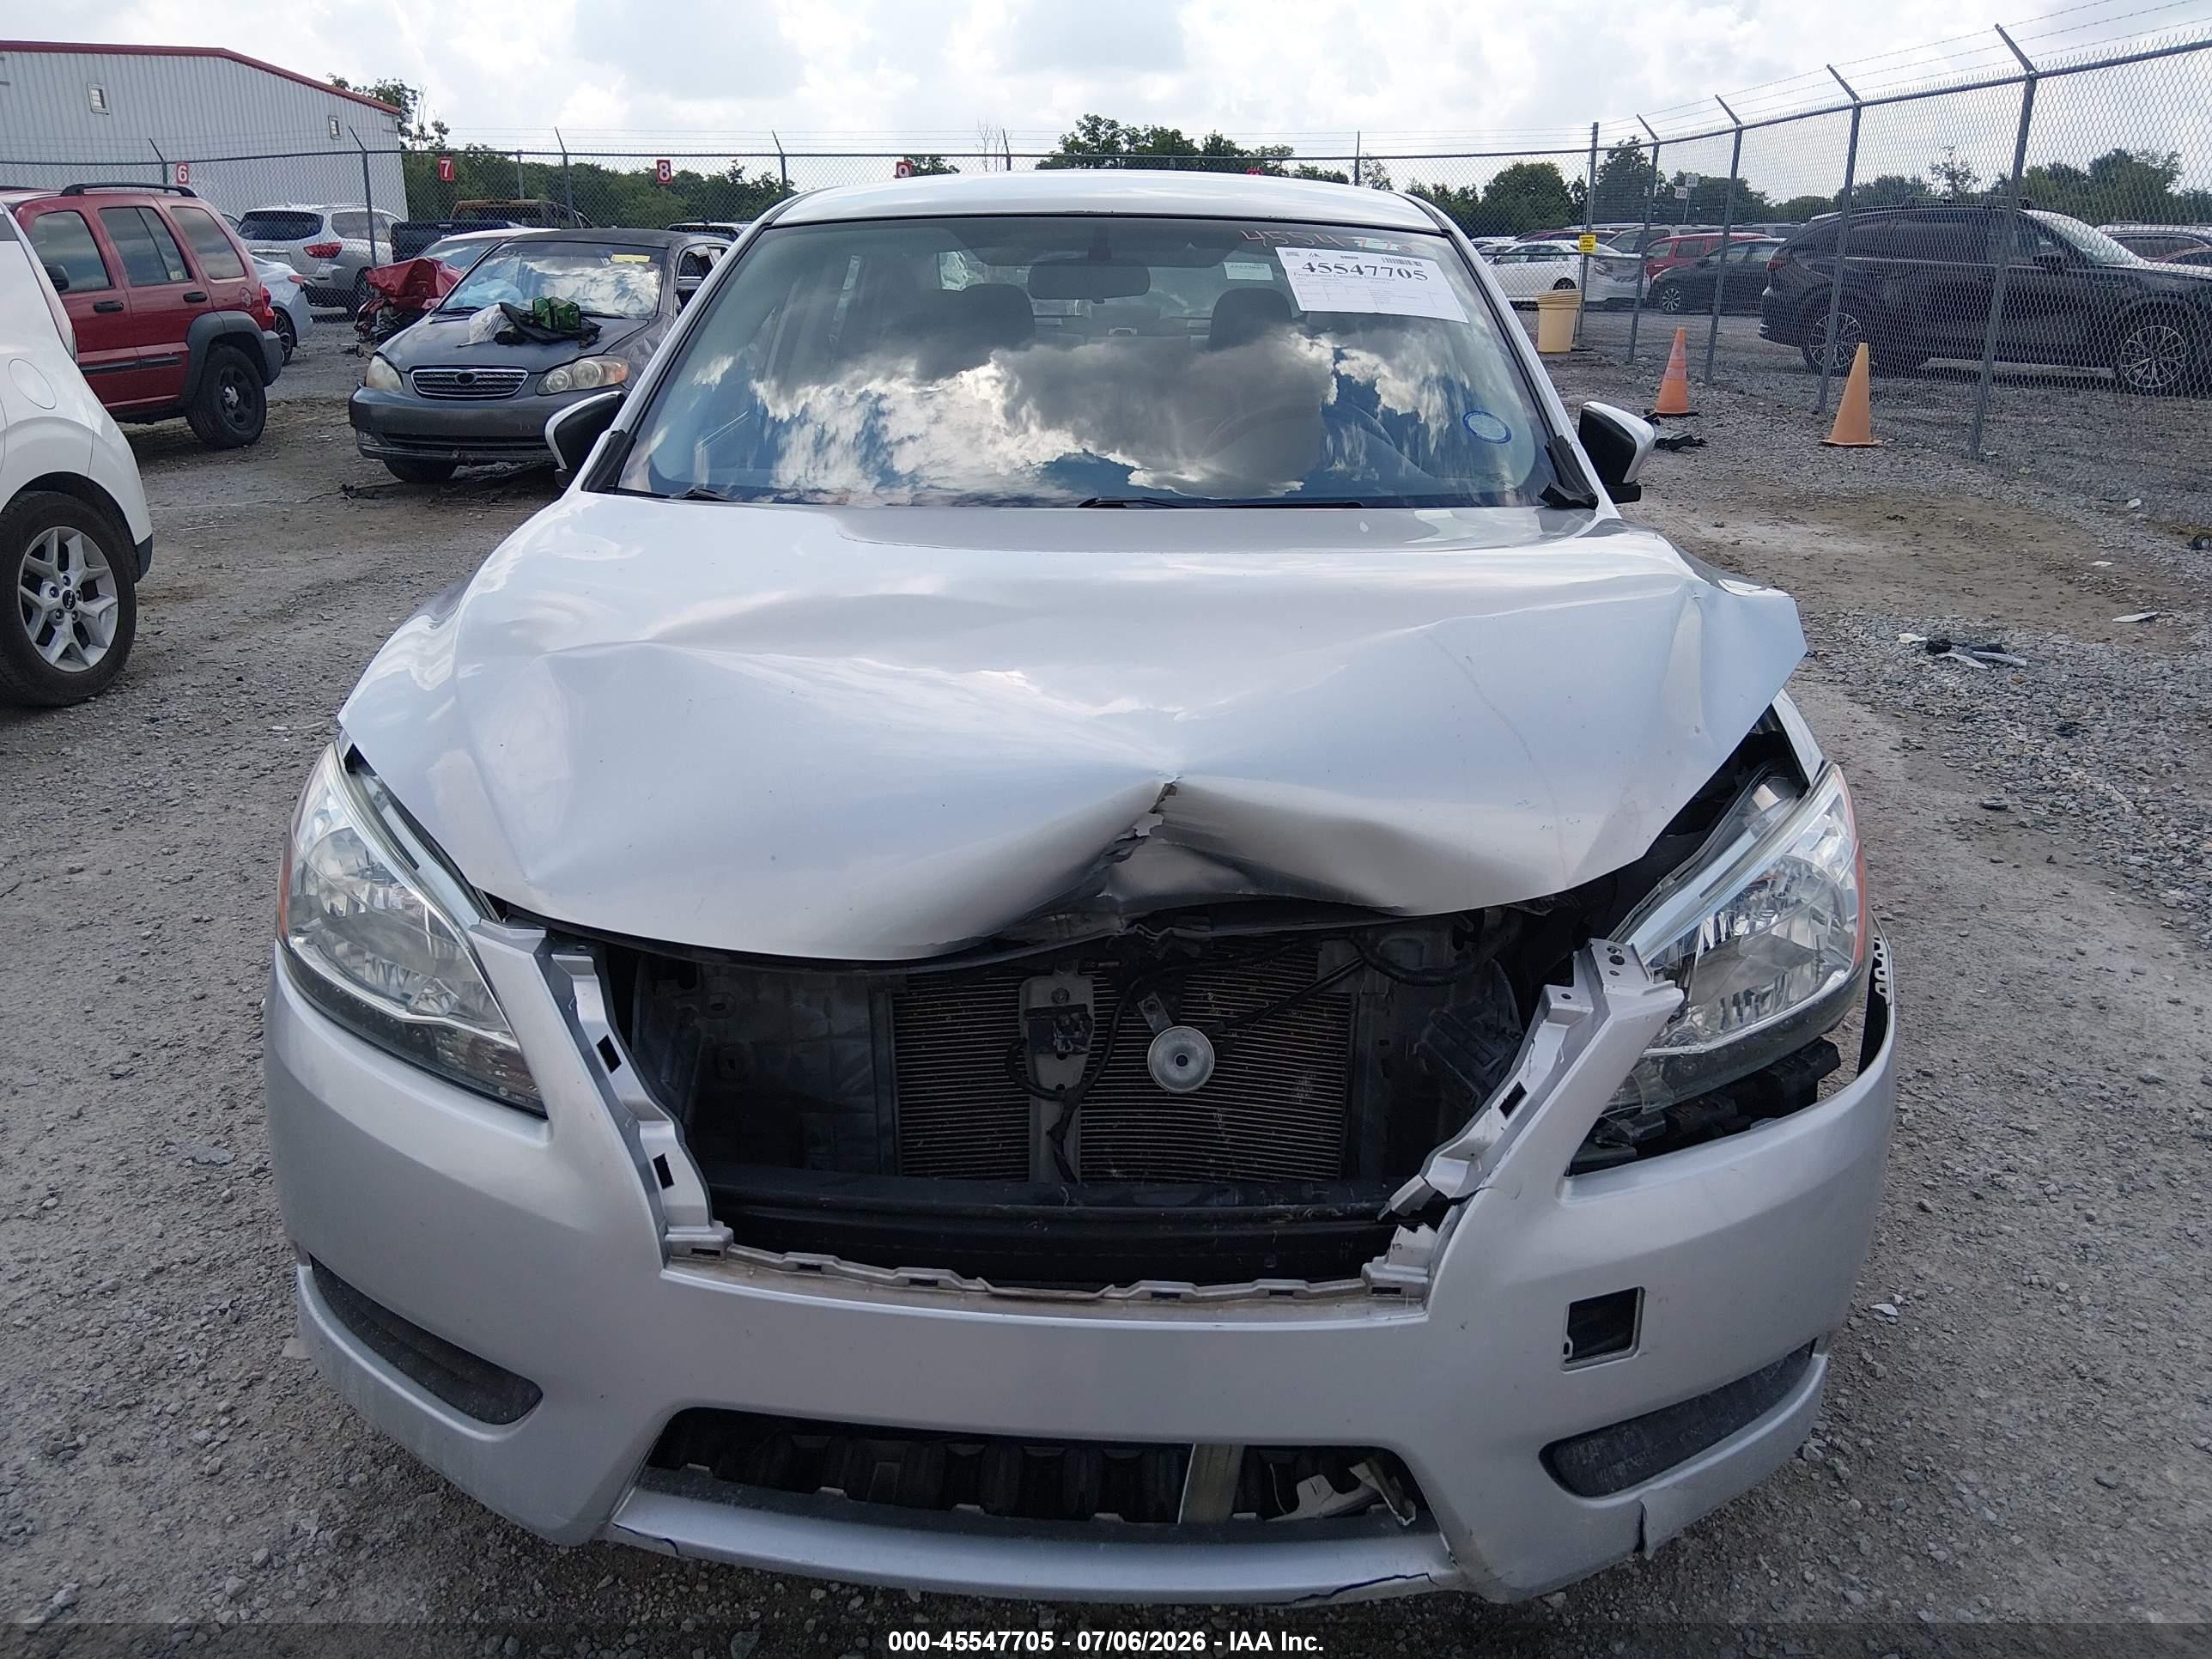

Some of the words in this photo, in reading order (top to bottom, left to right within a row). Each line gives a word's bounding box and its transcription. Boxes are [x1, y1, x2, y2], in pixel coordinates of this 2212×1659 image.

[178, 165, 188, 182] 6
[441, 160, 451, 178] 7
[659, 161, 671, 181] 8
[1302, 262, 1428, 282] 45547705
